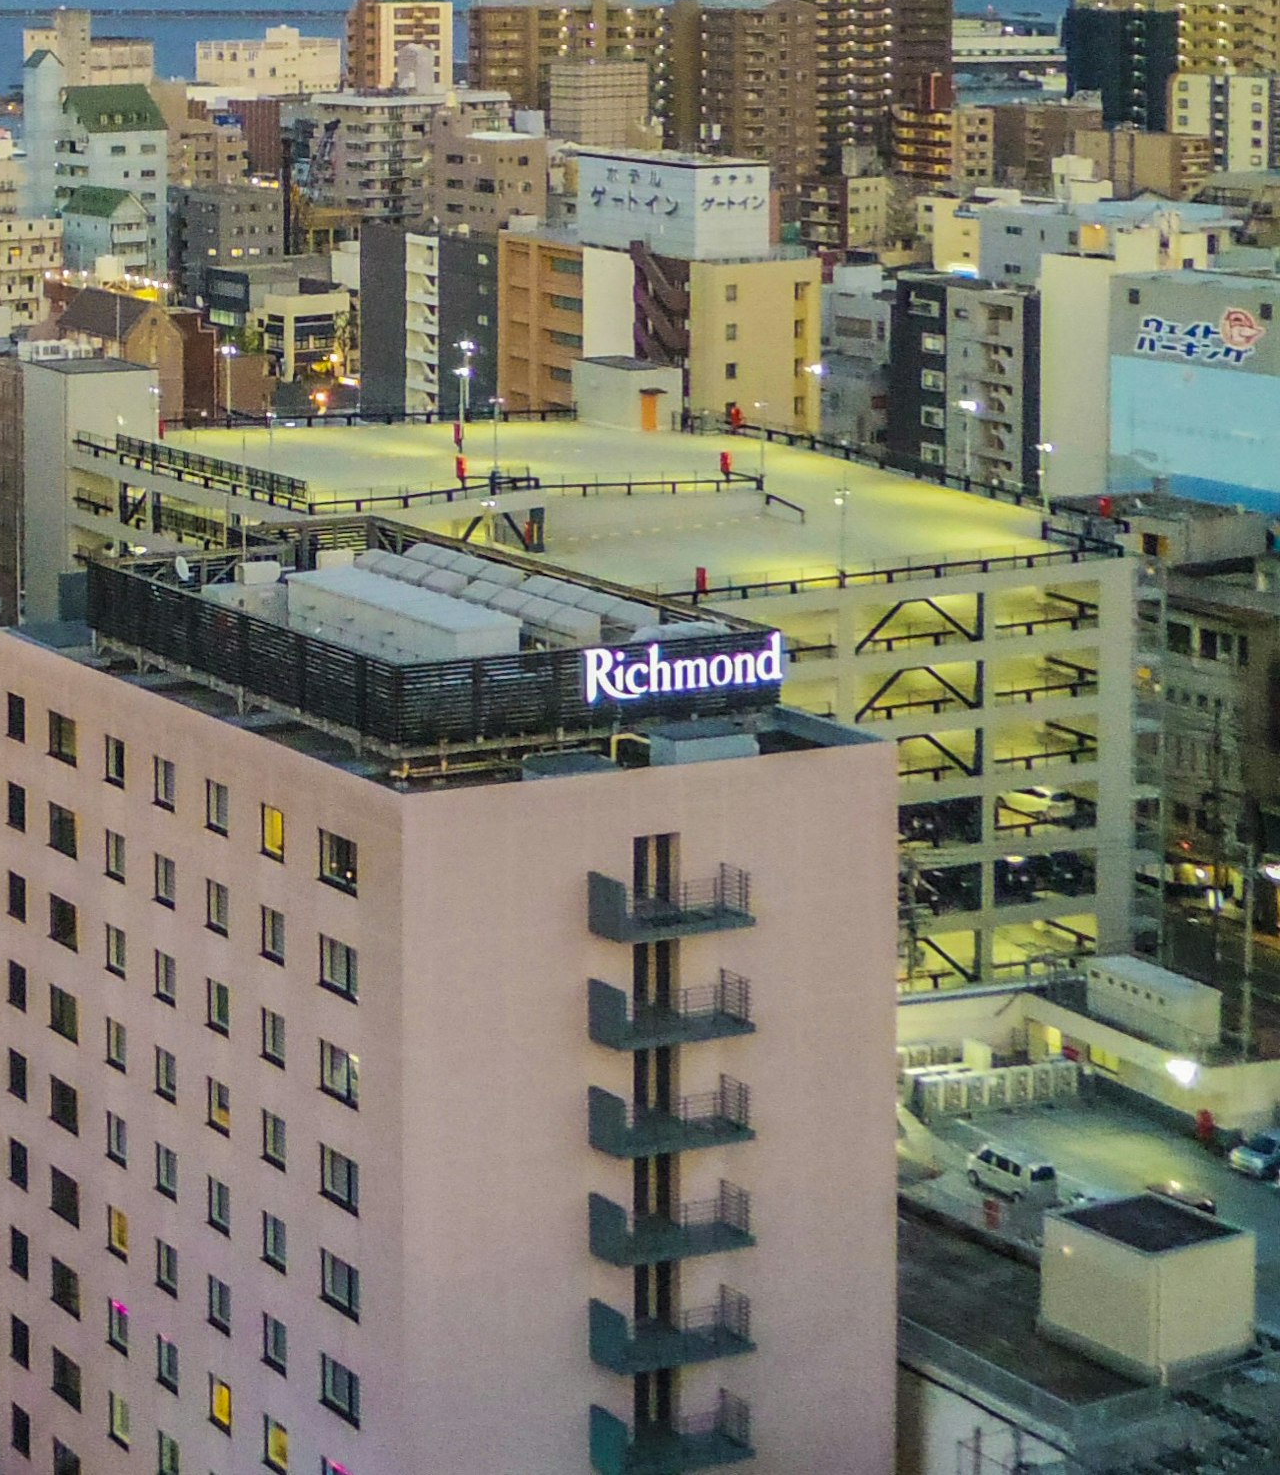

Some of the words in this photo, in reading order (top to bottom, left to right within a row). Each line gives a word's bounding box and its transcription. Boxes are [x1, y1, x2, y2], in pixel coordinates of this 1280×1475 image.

[606, 166, 662, 188] ホテル
[711, 174, 755, 186] ホテル
[590, 185, 680, 217] ゲートイン
[701, 195, 766, 212] ゲートイン
[1142, 315, 1222, 340] ウェイト
[1135, 334, 1254, 364] パーキング
[583, 630, 784, 704] Richmond
